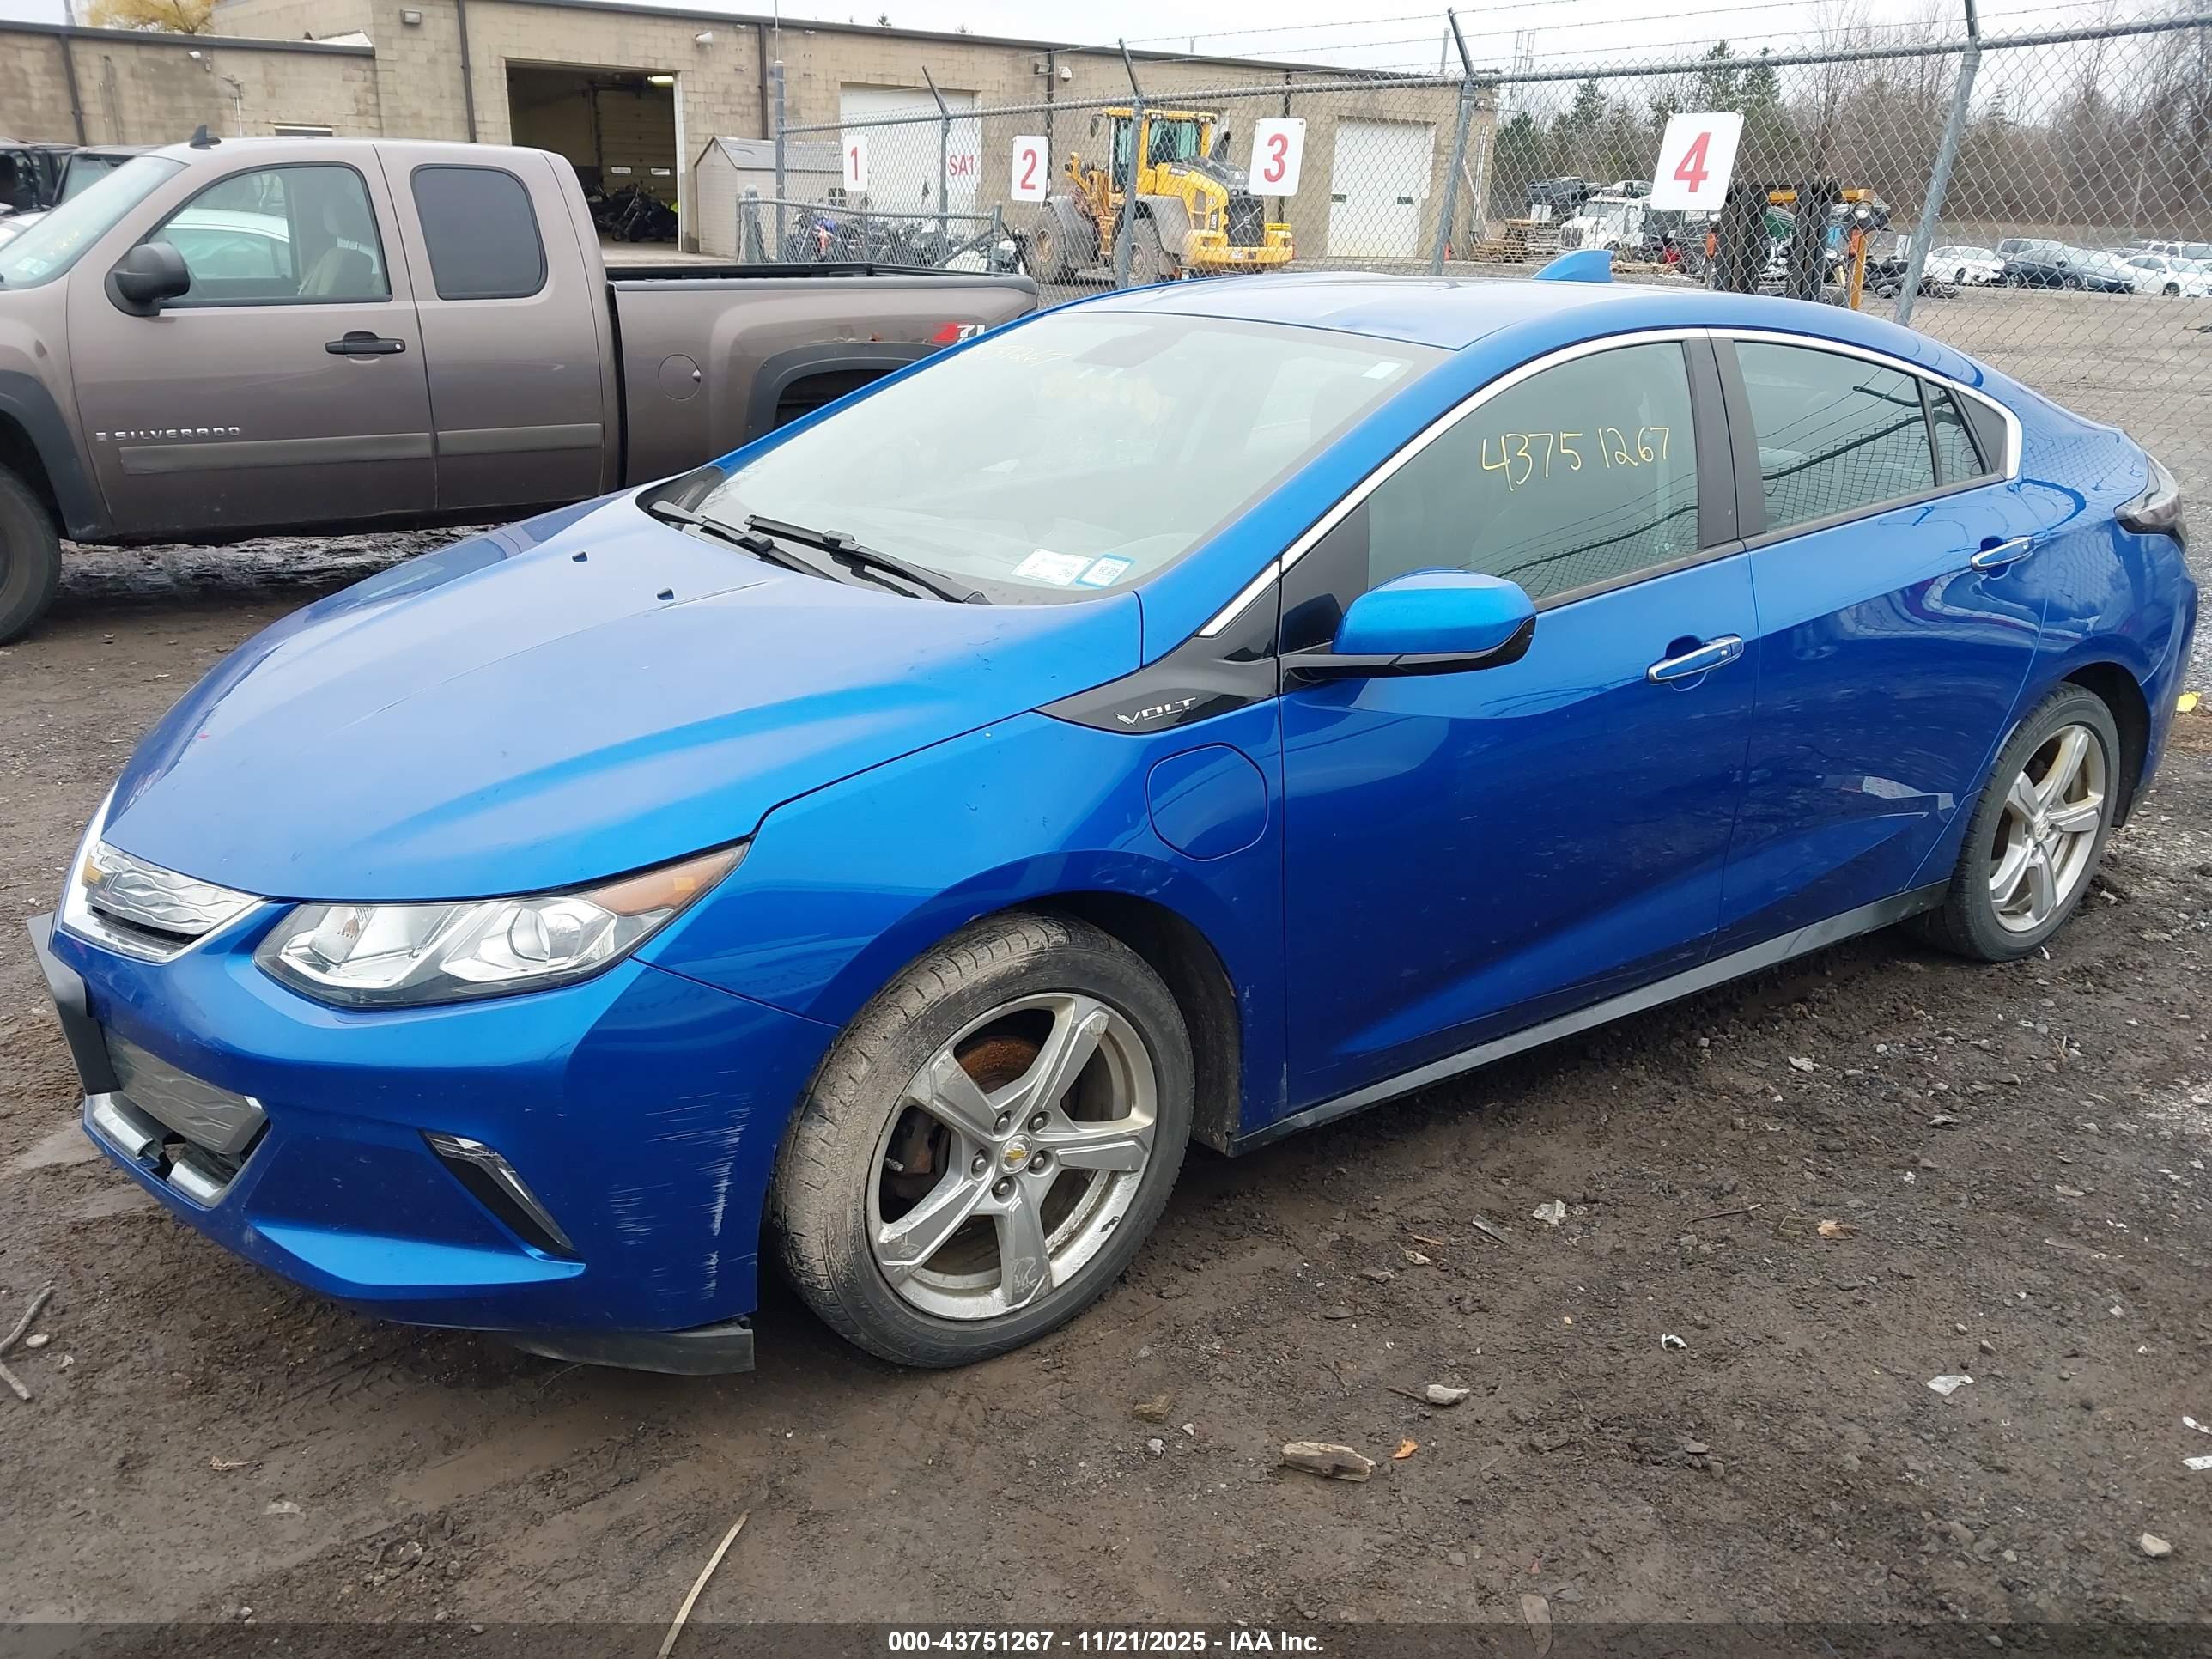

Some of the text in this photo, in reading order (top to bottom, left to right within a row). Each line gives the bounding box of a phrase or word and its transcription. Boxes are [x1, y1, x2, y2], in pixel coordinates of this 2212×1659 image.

[850, 146, 859, 181] 1
[949, 155, 975, 176] SA1
[1020, 149, 1037, 190] 2
[1263, 133, 1289, 183] 3
[1674, 131, 1711, 193] 4
[114, 427, 240, 441] SILVERADO
[1114, 696, 1197, 726] VOLT
